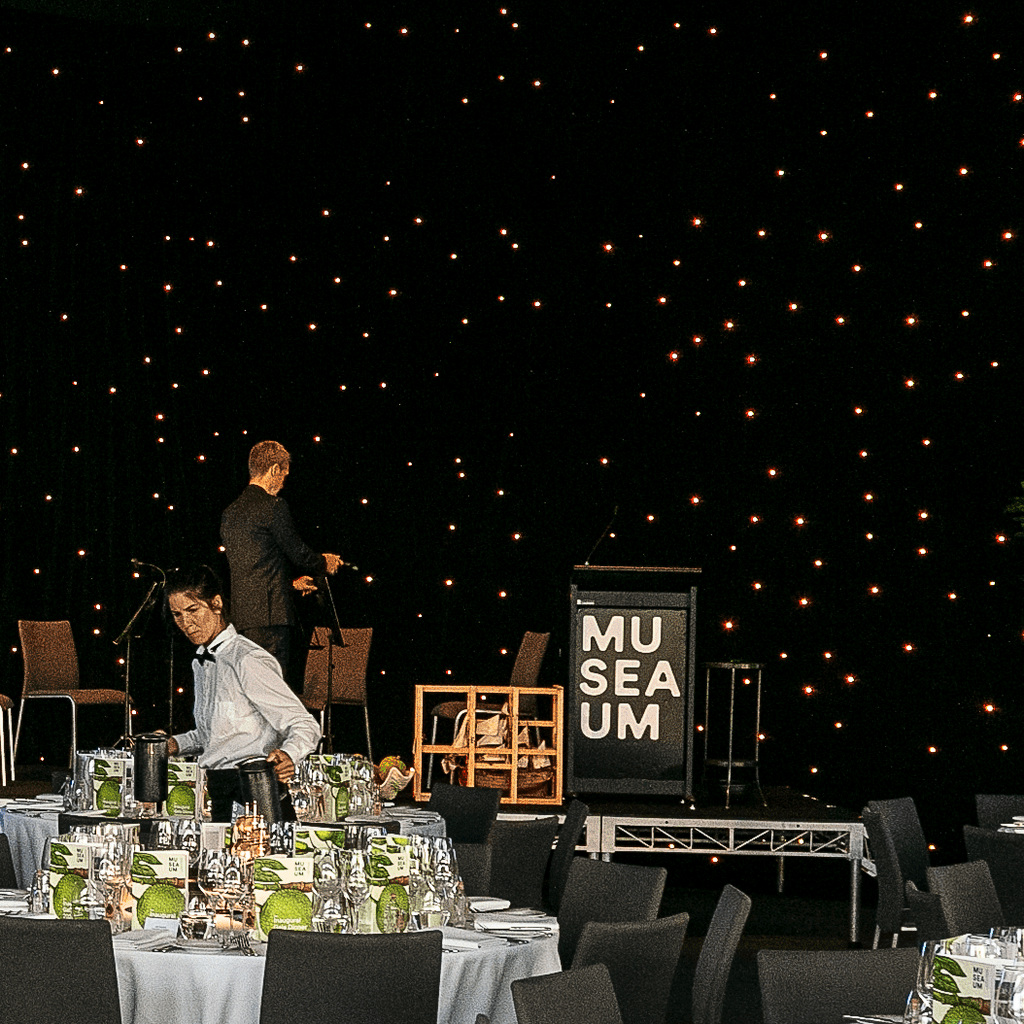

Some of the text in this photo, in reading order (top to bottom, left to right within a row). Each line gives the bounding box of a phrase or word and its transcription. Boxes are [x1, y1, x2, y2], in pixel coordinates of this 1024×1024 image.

[582, 615, 662, 653] MU
[579, 658, 681, 697] SEA
[580, 702, 660, 741] UM
